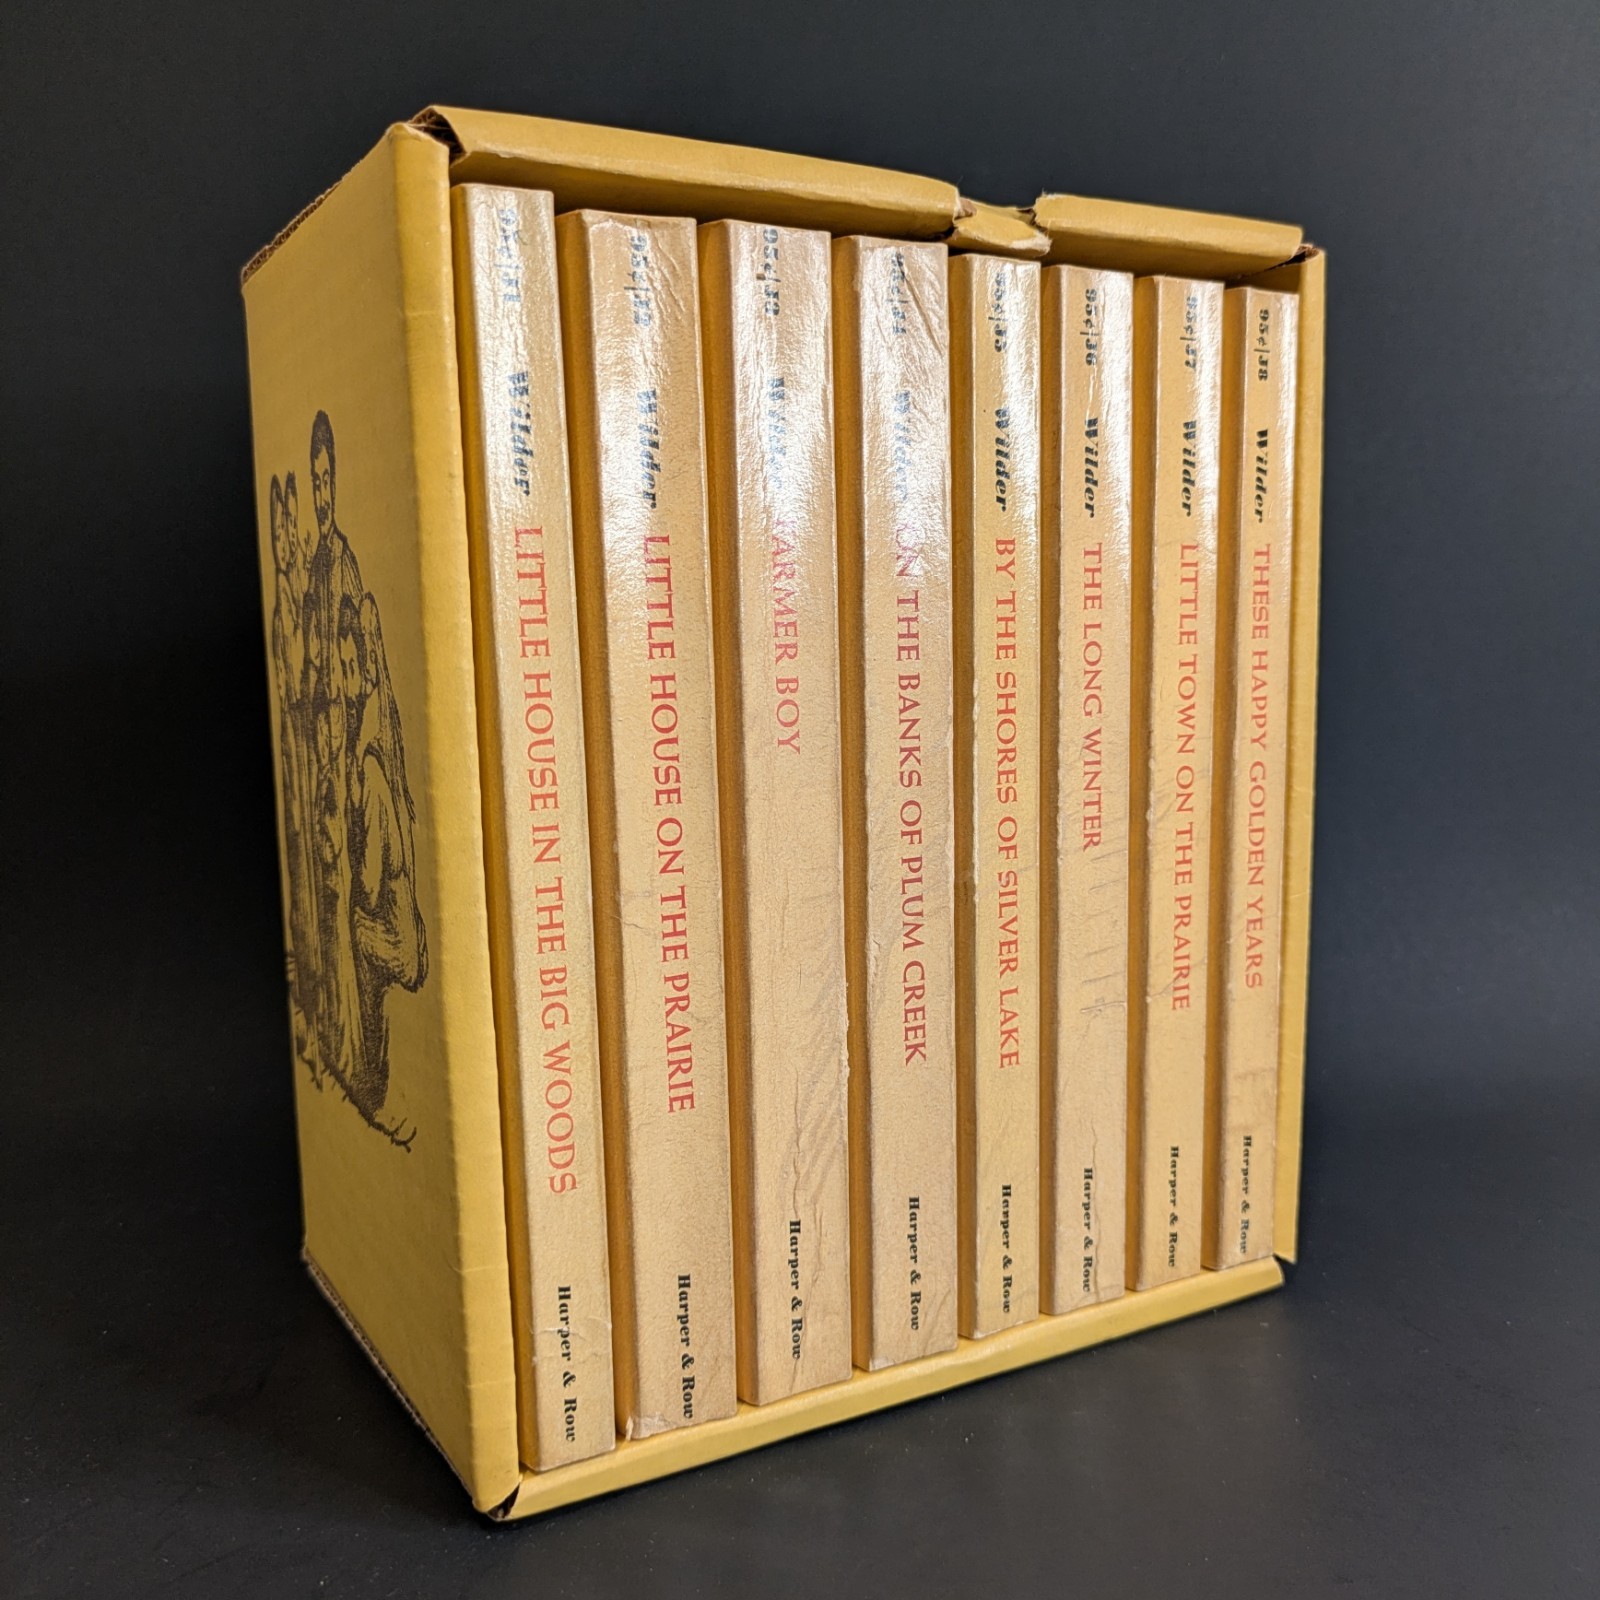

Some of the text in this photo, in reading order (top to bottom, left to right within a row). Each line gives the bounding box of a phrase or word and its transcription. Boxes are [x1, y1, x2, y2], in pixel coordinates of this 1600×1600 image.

[506, 370, 535, 496] Wilder
[637, 389, 661, 508] Wilder
[994, 406, 1014, 513] Wilder
[1084, 416, 1100, 519] Wilder
[1181, 419, 1199, 517] Wilder
[1253, 428, 1269, 523] Wilder
[514, 527, 550, 659] LITTLE
[995, 538, 1017, 580] BY
[1082, 543, 1104, 609] THE
[1178, 544, 1200, 645] LITTLE
[1253, 544, 1271, 638] THESE
[643, 534, 676, 661] LITTLE
[896, 590, 920, 661] THE
[995, 590, 1017, 660] THE
[1083, 622, 1104, 717] LONG
[1177, 654, 1198, 754] TOWN
[1250, 650, 1268, 749] HAPPY
[523, 672, 559, 812] HOUSE
[649, 673, 683, 807] HOUSE
[775, 677, 800, 753] BOY
[897, 672, 922, 788] BANKS
[996, 671, 1017, 804] SHORES
[900, 800, 923, 846] OF
[1082, 728, 1103, 849] WINTER
[1176, 765, 1194, 813] ON
[1248, 760, 1267, 885] GOLDEN
[531, 824, 561, 864] IN
[656, 816, 686, 876] ON
[996, 815, 1018, 861] OF
[1174, 822, 1193, 885] THE
[534, 875, 566, 955] THE
[659, 884, 689, 963] THE
[900, 856, 925, 950] PLUM
[997, 869, 1020, 977] SILVER
[1171, 895, 1192, 1010] PRAIRIE
[1245, 897, 1264, 989] YEARS
[539, 966, 569, 1030] BIG
[902, 960, 927, 1065] CREEK
[999, 987, 1020, 1069] LAKE
[663, 972, 695, 1114] PRAIRIE
[544, 1041, 577, 1195] WOODS
[1081, 1167, 1094, 1231] Harper
[1168, 1145, 1180, 1208] Harper
[1240, 1135, 1253, 1195] Harper
[906, 1195, 921, 1265] Harper
[999, 1183, 1012, 1250] Harper
[1083, 1235, 1094, 1250] &
[1169, 1211, 1179, 1226] &
[1240, 1219, 1250, 1254] Row
[1241, 1199, 1251, 1214] &
[787, 1218, 802, 1291] Harper
[909, 1269, 922, 1285] &
[1002, 1254, 1013, 1269] &
[1082, 1255, 1095, 1293] Row
[1168, 1231, 1178, 1268] Row
[556, 1285, 572, 1362] Harper
[676, 1273, 692, 1348] Harper
[790, 1295, 803, 1313] &
[910, 1290, 922, 1331] Row
[1002, 1274, 1013, 1314] Row
[681, 1352, 695, 1371] &
[791, 1316, 804, 1361] Row
[562, 1370, 577, 1389] &
[681, 1375, 696, 1420] Row
[563, 1397, 578, 1443] Row
